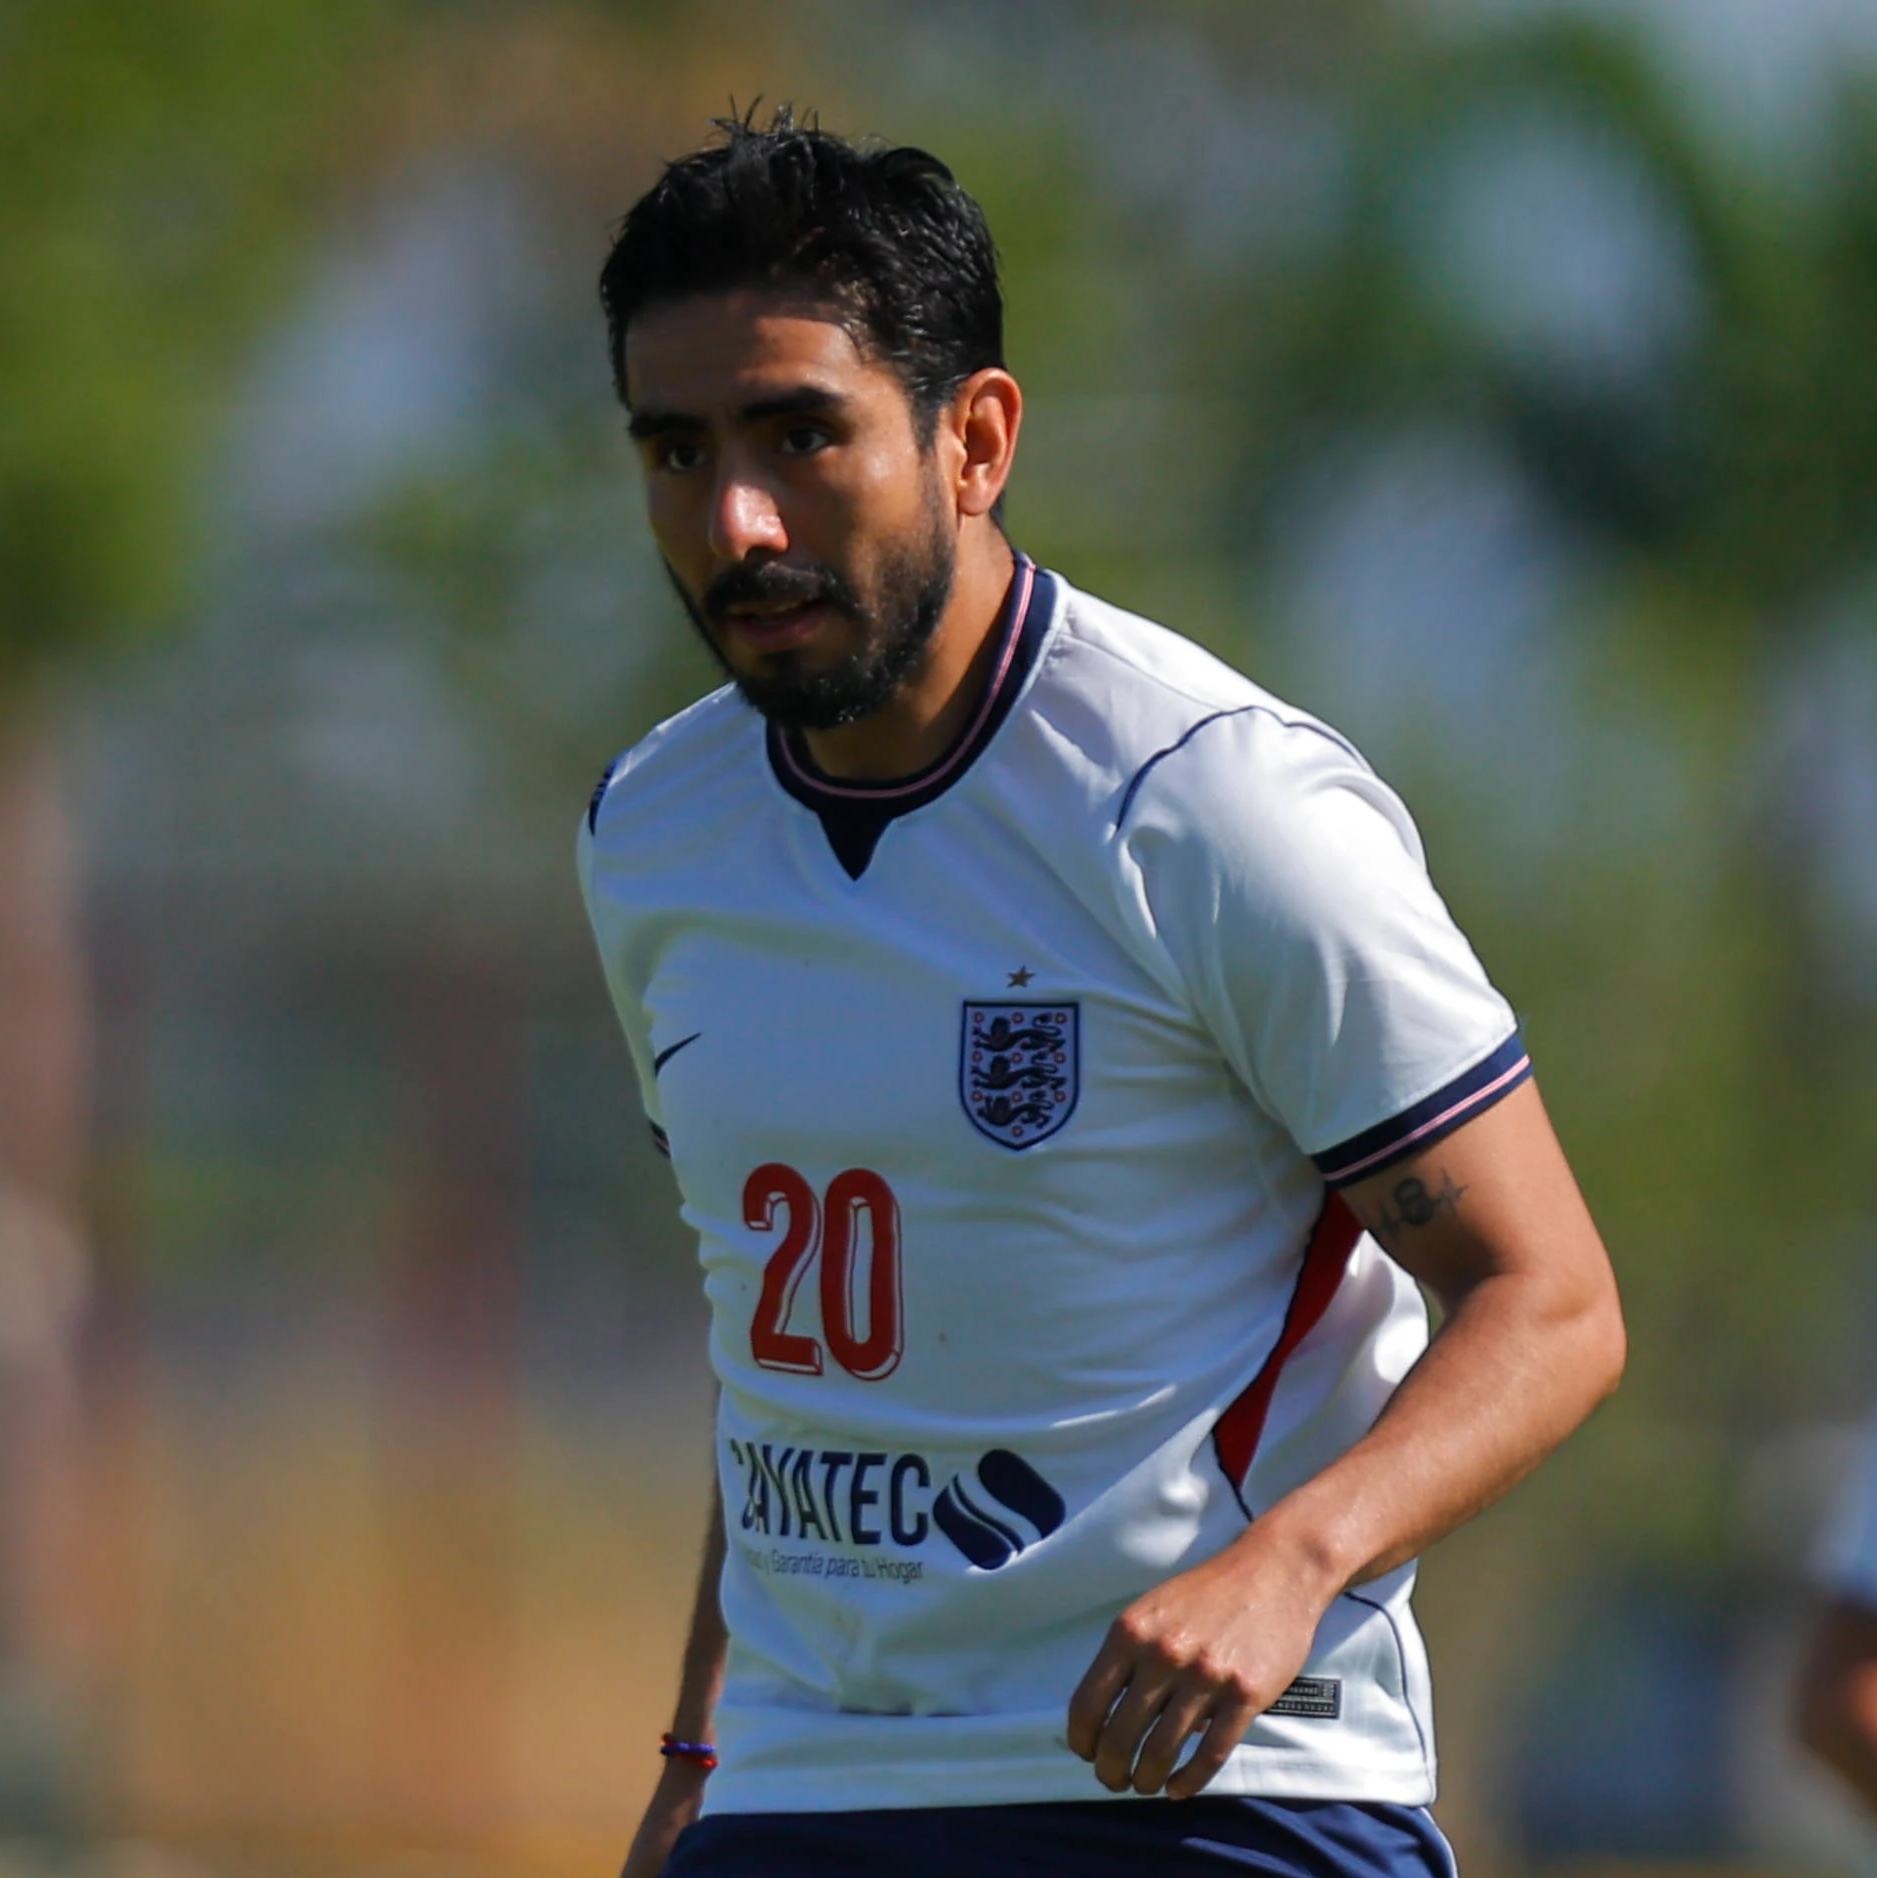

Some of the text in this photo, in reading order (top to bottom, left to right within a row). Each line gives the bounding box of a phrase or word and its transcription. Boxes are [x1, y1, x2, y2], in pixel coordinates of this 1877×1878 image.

[744, 1162, 905, 1382] 20
[824, 1558, 860, 1580] para
[876, 1557, 924, 1584] Hogar
